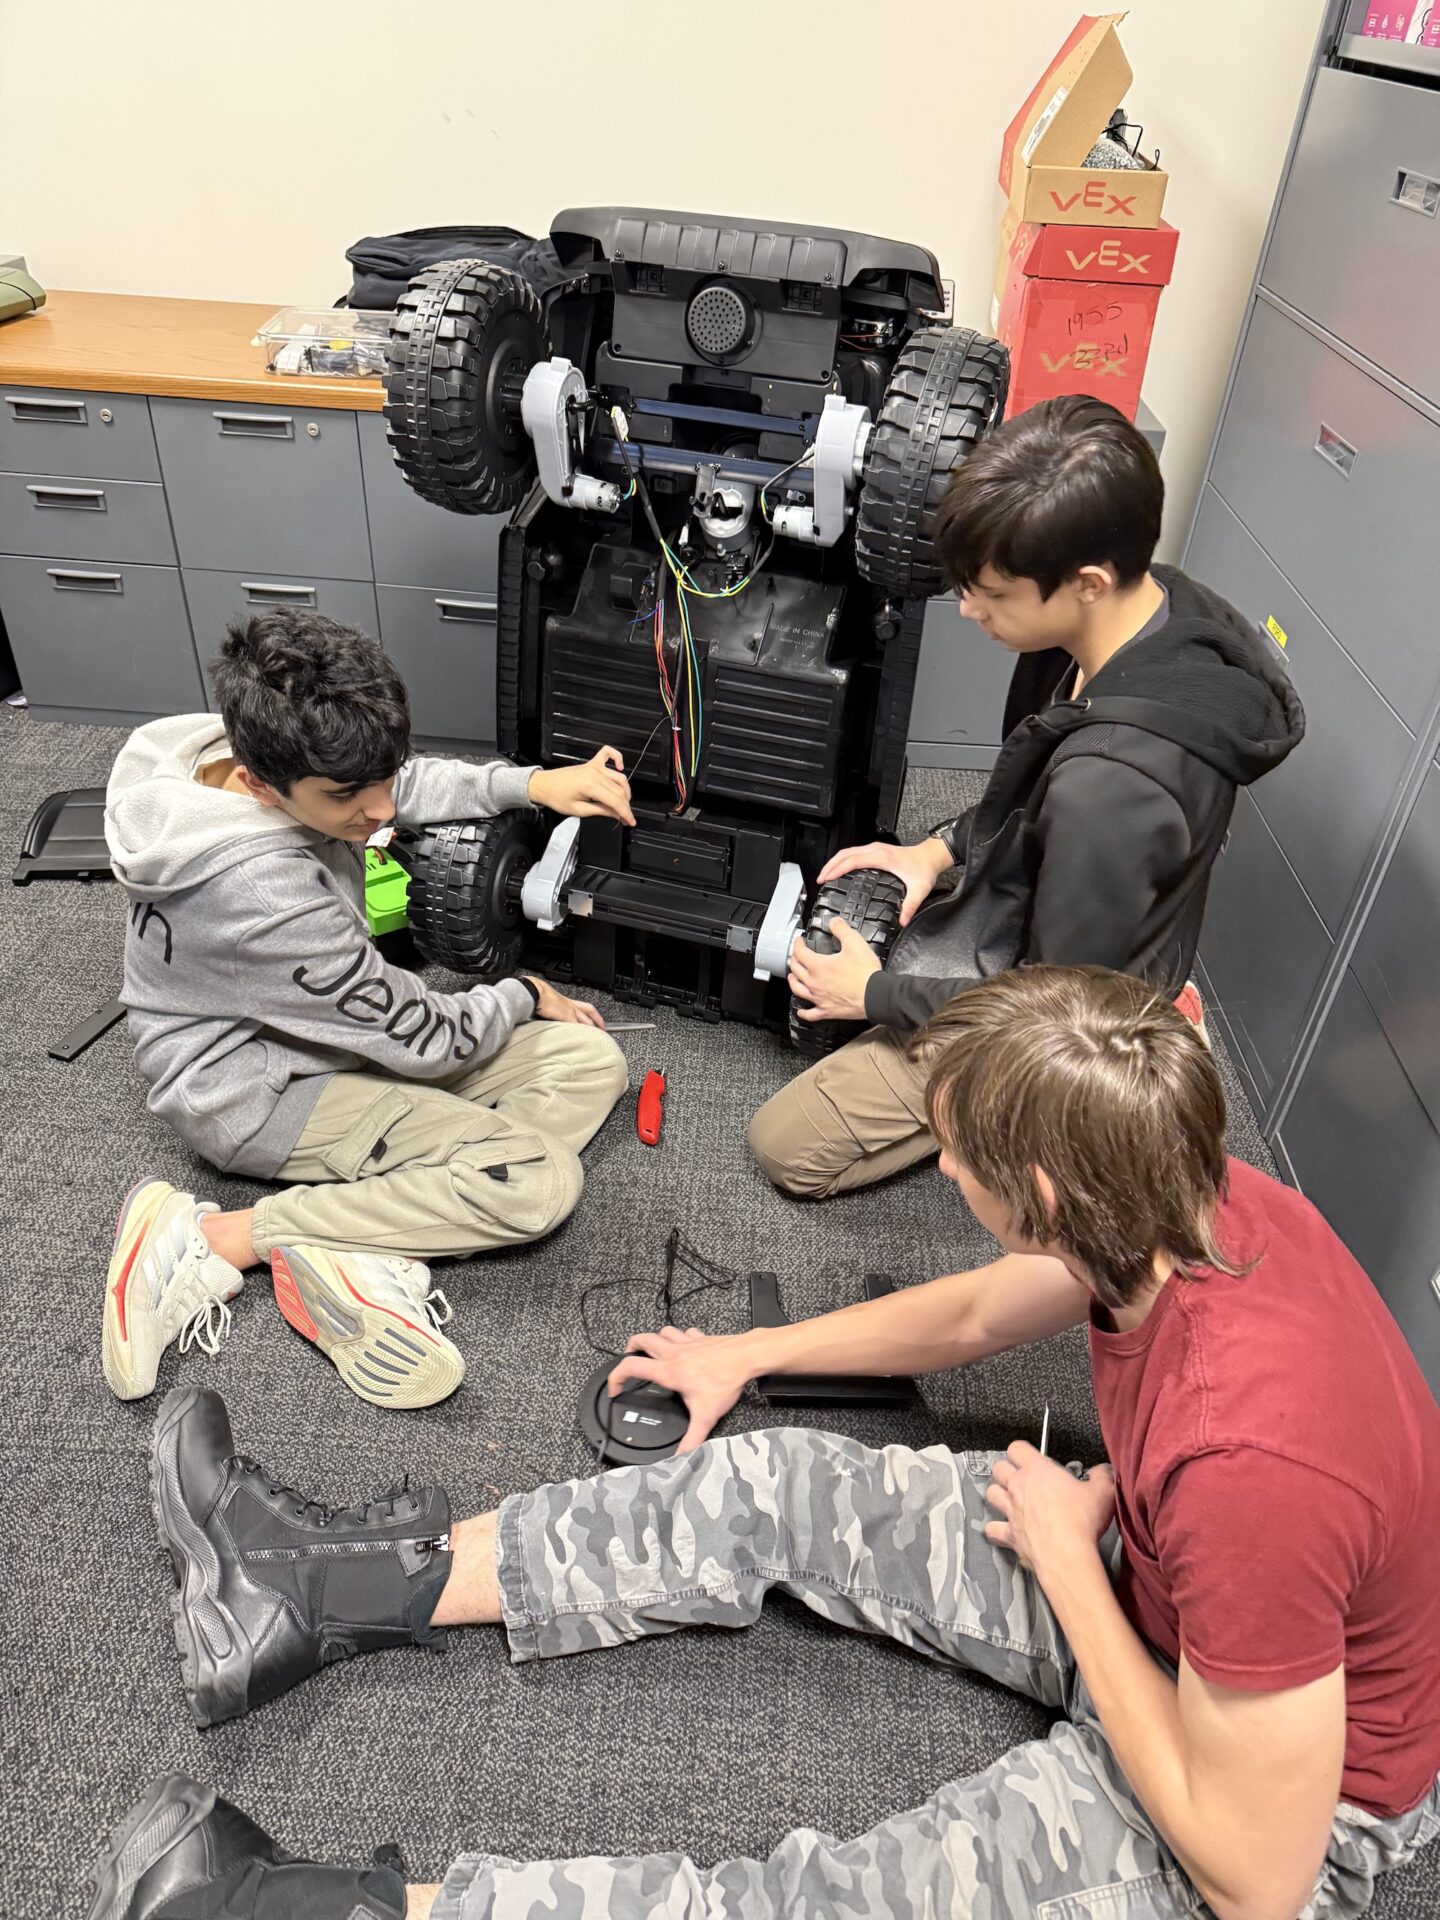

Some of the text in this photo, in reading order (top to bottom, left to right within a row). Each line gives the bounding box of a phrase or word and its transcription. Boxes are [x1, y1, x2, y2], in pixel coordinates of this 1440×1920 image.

[1050, 181, 1137, 216] VEX
[1065, 240, 1152, 274] VEX
[792, 627, 800, 635] IN
[802, 629, 825, 638] CHINA
[292, 945, 479, 1062] Jeans
